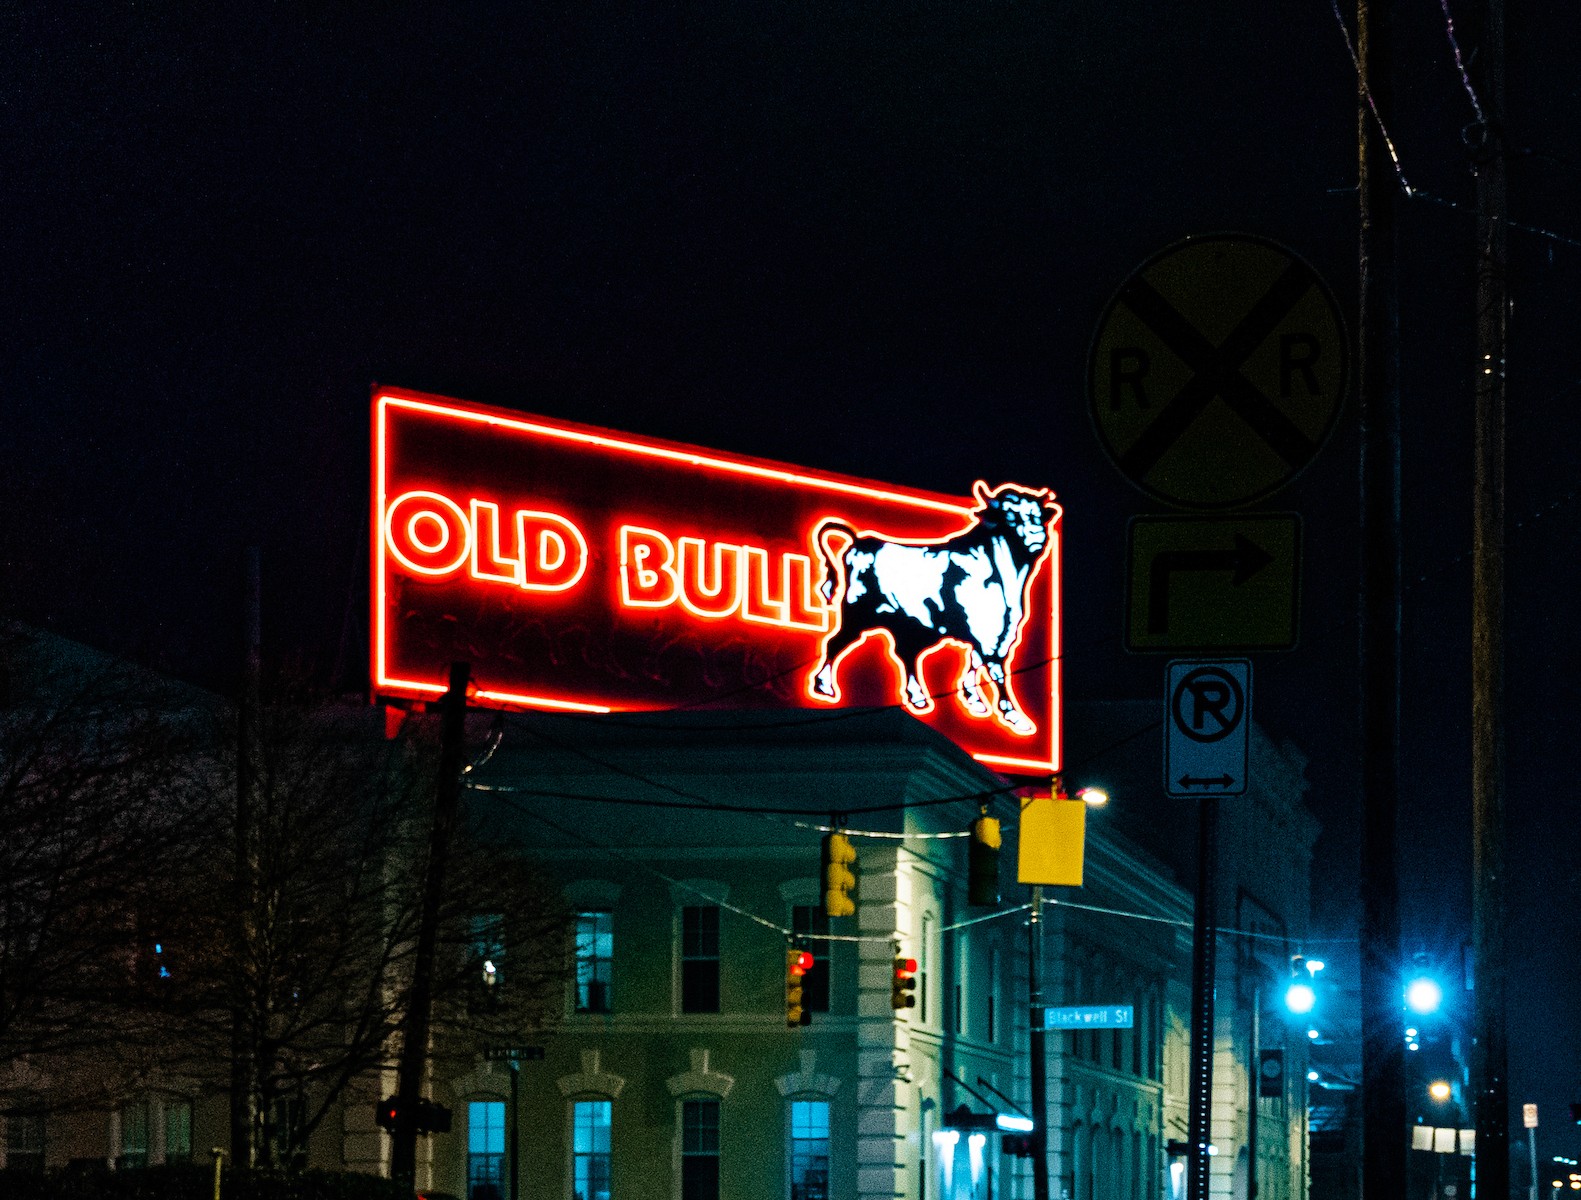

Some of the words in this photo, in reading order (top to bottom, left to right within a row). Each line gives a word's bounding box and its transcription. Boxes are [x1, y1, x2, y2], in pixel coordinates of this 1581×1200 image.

[1111, 347, 1151, 411] R
[1280, 332, 1322, 398] R
[385, 489, 590, 594] OLD
[619, 523, 831, 633] BULL
[1048, 1010, 1108, 1025] Blackwell
[1115, 1009, 1129, 1024] St
